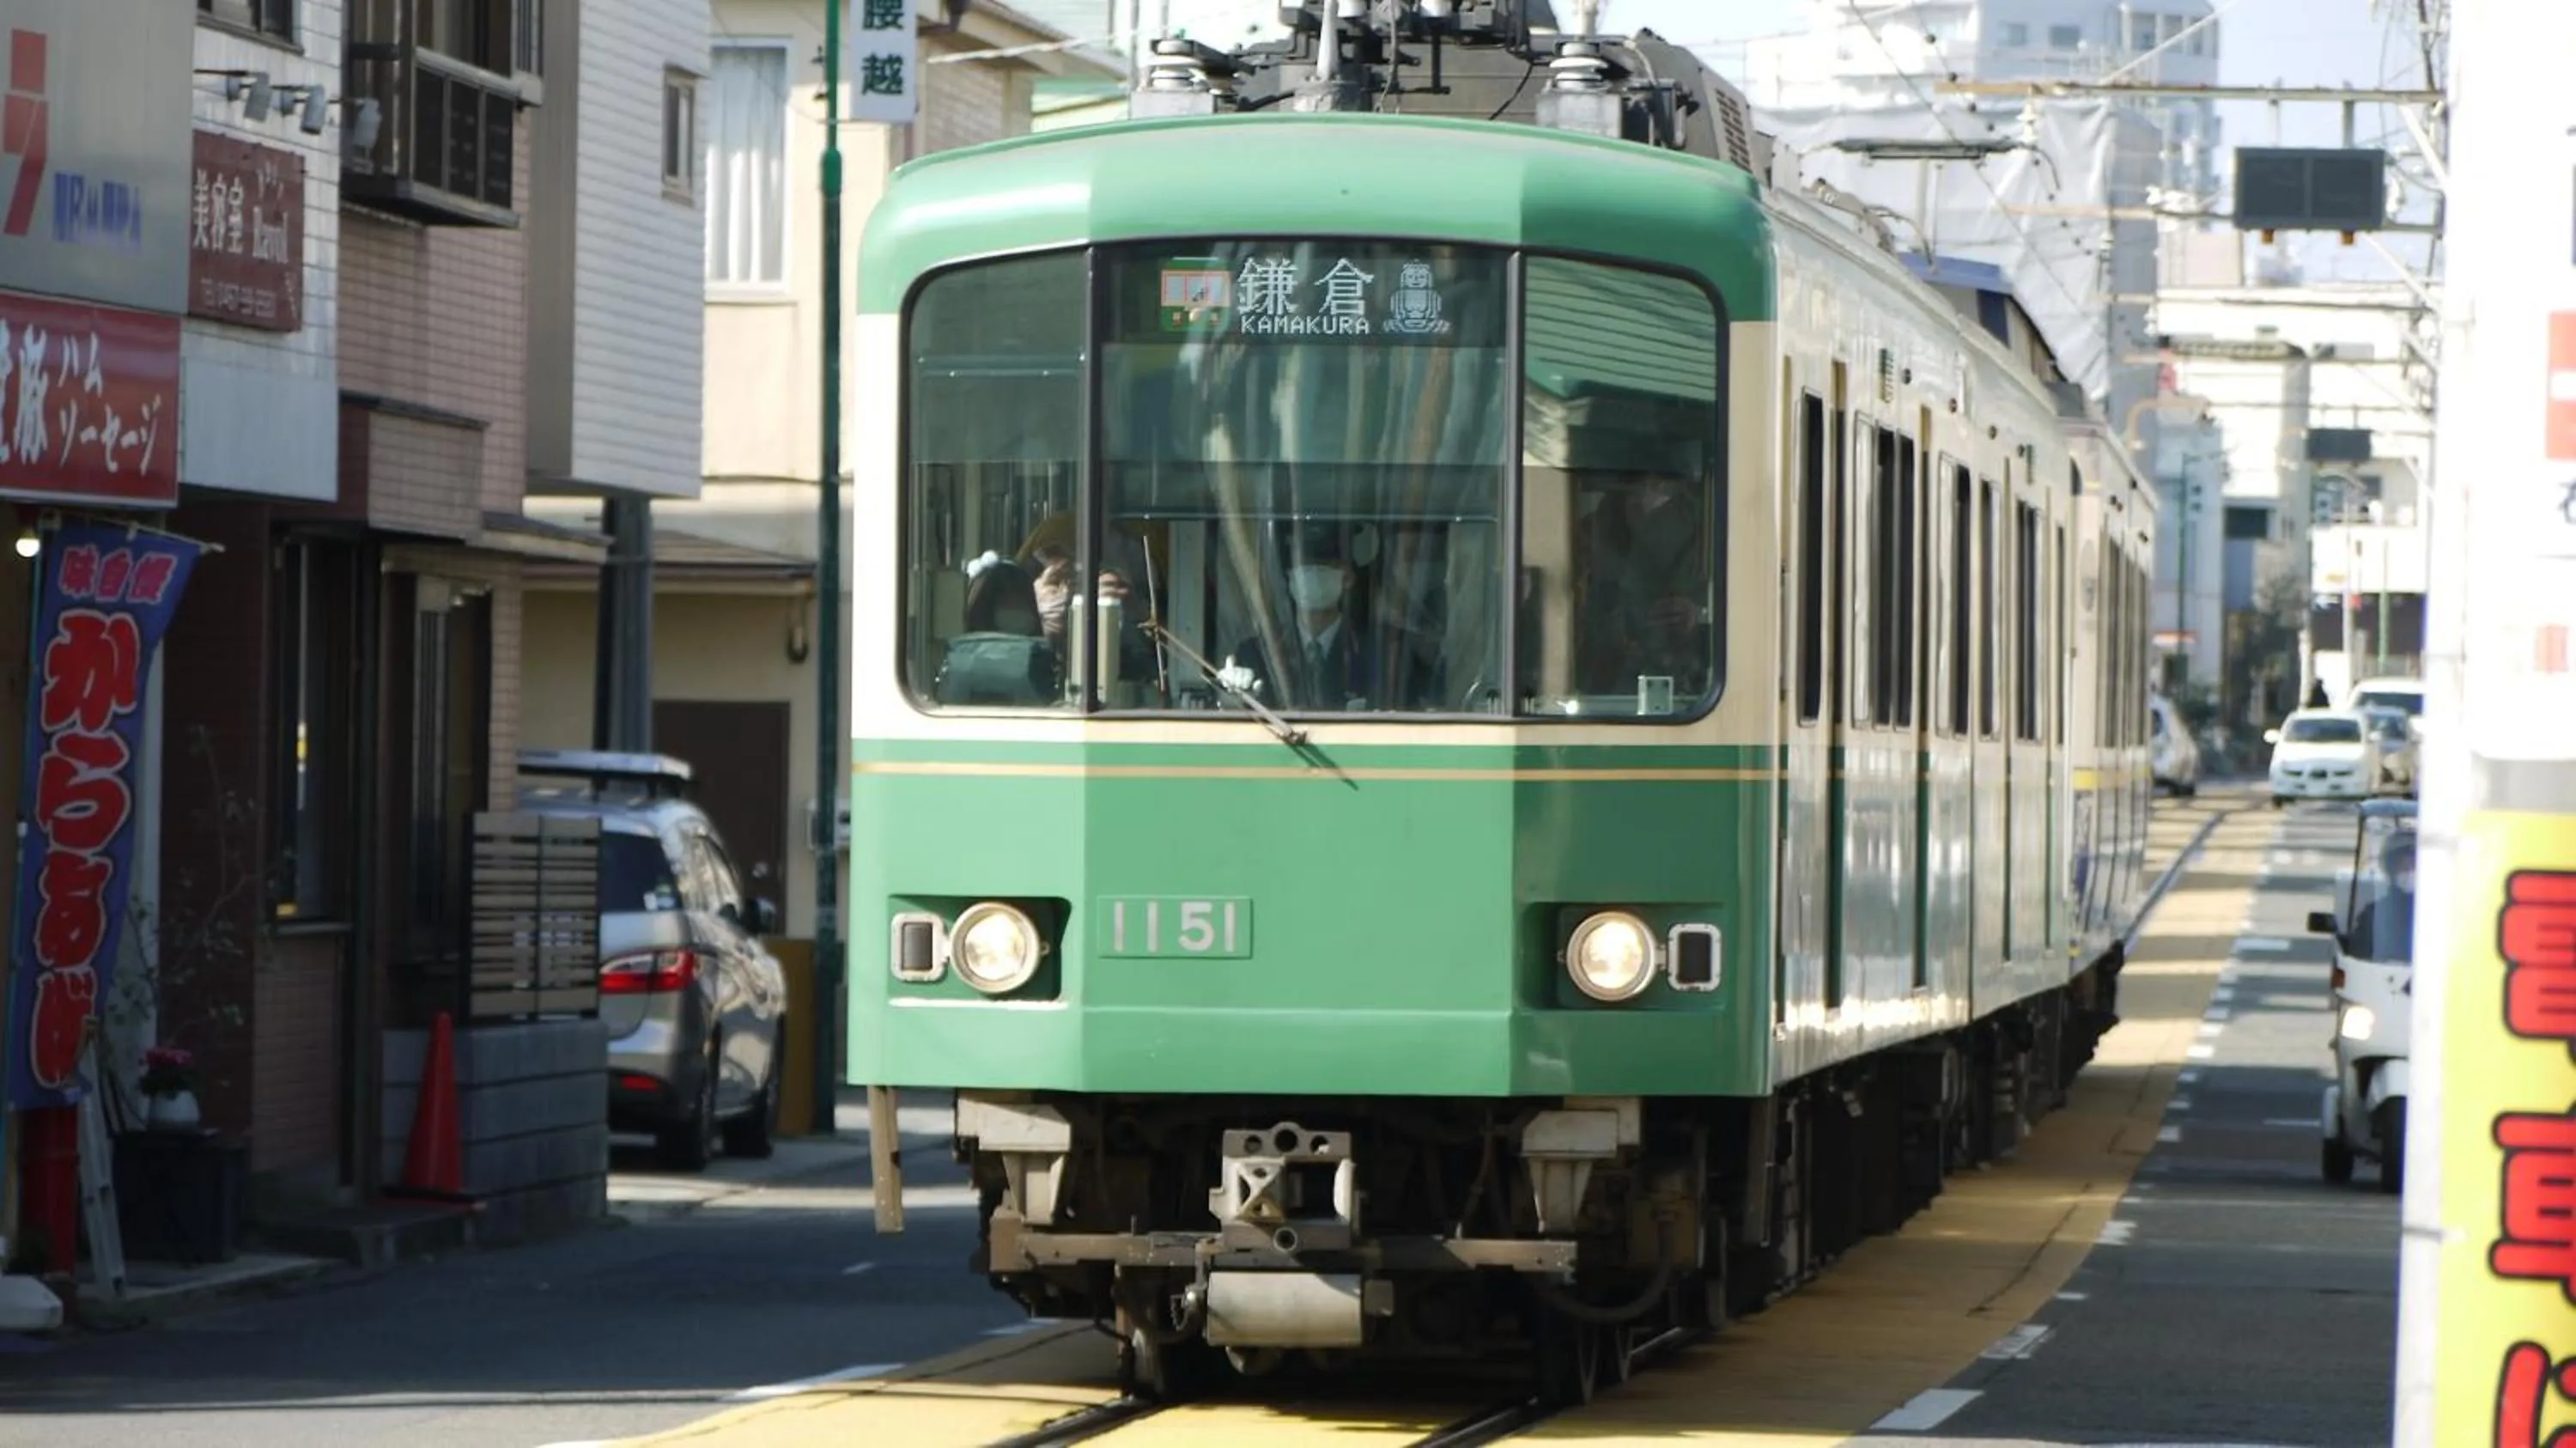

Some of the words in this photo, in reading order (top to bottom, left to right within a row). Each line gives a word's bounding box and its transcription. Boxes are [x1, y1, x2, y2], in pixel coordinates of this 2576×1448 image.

[862, 0, 904, 95] 腰越
[193, 168, 245, 254] 美容室
[1237, 257, 1374, 316] 鎌倉
[1240, 314, 1370, 335] KAMAKURA
[58, 331, 103, 399] ハム
[59, 394, 162, 478] ソーセージ
[30, 609, 140, 1091] からあげ
[1114, 900, 1236, 953] 1151
